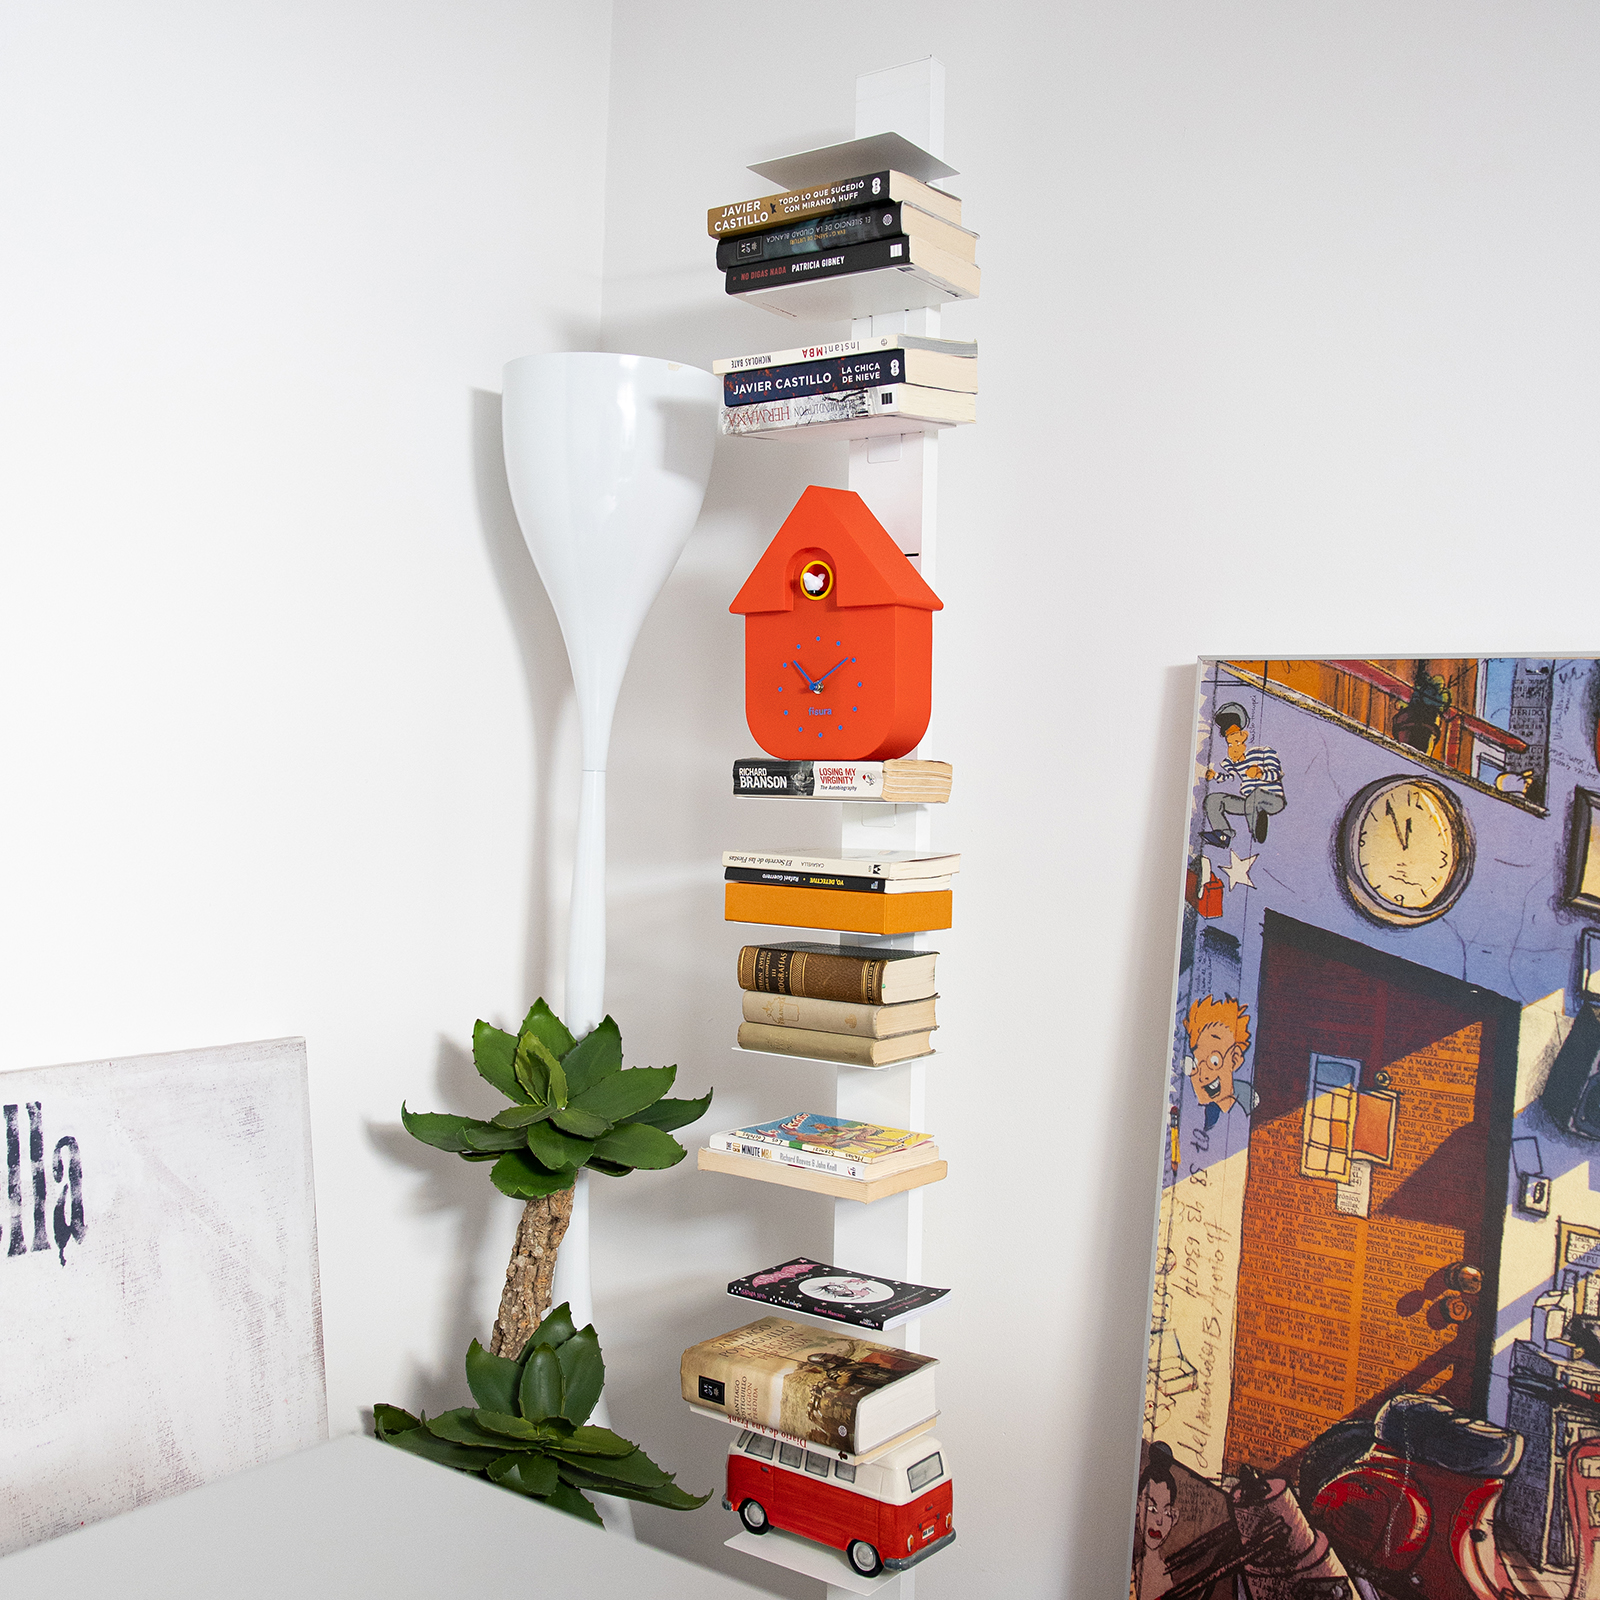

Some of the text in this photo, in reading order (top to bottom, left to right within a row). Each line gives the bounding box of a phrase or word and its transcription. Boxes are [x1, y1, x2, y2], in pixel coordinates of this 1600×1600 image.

[779, 195, 799, 206] TODO
[802, 192, 812, 201] LO
[813, 188, 829, 199] QUE
[831, 180, 865, 195] SUCEDIÓ
[784, 191, 859, 213] CON MIRANDA HUFF
[721, 200, 761, 218] JAVIER
[714, 211, 769, 232] CASTILLO
[766, 215, 871, 244] EL SILENCIO DE LA CIUDAD BLANCA
[741, 255, 845, 281] NO DIGAS NADA PATRICIA GIBNEY
[731, 354, 772, 369] NICHOLAS BATE
[841, 366, 853, 375] LA
[854, 362, 881, 373] CHICA
[733, 372, 832, 396] JAVIER CASTILLO
[842, 371, 881, 384] DE NIEVE
[808, 707, 832, 716] fisura
[738, 767, 767, 776] RICHARD
[818, 767, 856, 777] LOSING MY
[740, 776, 787, 788] BRANSON
[819, 776, 854, 785] VIRGINITY
[728, 855, 748, 864] Fiestas
[765, 858, 786, 866] Secreto
[762, 873, 783, 881] Guerrero
[784, 874, 799, 882] Rafael
[810, 877, 836, 886] DETECTIVE
[1415, 1058, 1454, 1071] MARACAY
[741, 1144, 761, 1157] MINUTE
[761, 1148, 772, 1159] MBA
[779, 1152, 796, 1164] Richard
[796, 1156, 812, 1166] Reeves
[816, 1160, 826, 1169] John
[826, 1162, 838, 1172] Knell
[0, 1100, 88, 1267] lla
[1368, 1225, 1406, 1237] MARIACHI
[1365, 1256, 1402, 1269] MINITECA
[1364, 1274, 1423, 1291] PARA VELADAS
[711, 1324, 773, 1350] SANTIAGO
[718, 1325, 795, 1358] POSTEGUILLO
[1392, 1345, 1423, 1357] FIESTAS
[1357, 1361, 1384, 1373] FIESTA
[733, 1379, 741, 1415] SANTIAGO
[1246, 1399, 1277, 1412] TOYOTA
[727, 1414, 807, 1448] Diario de Ana Frank
